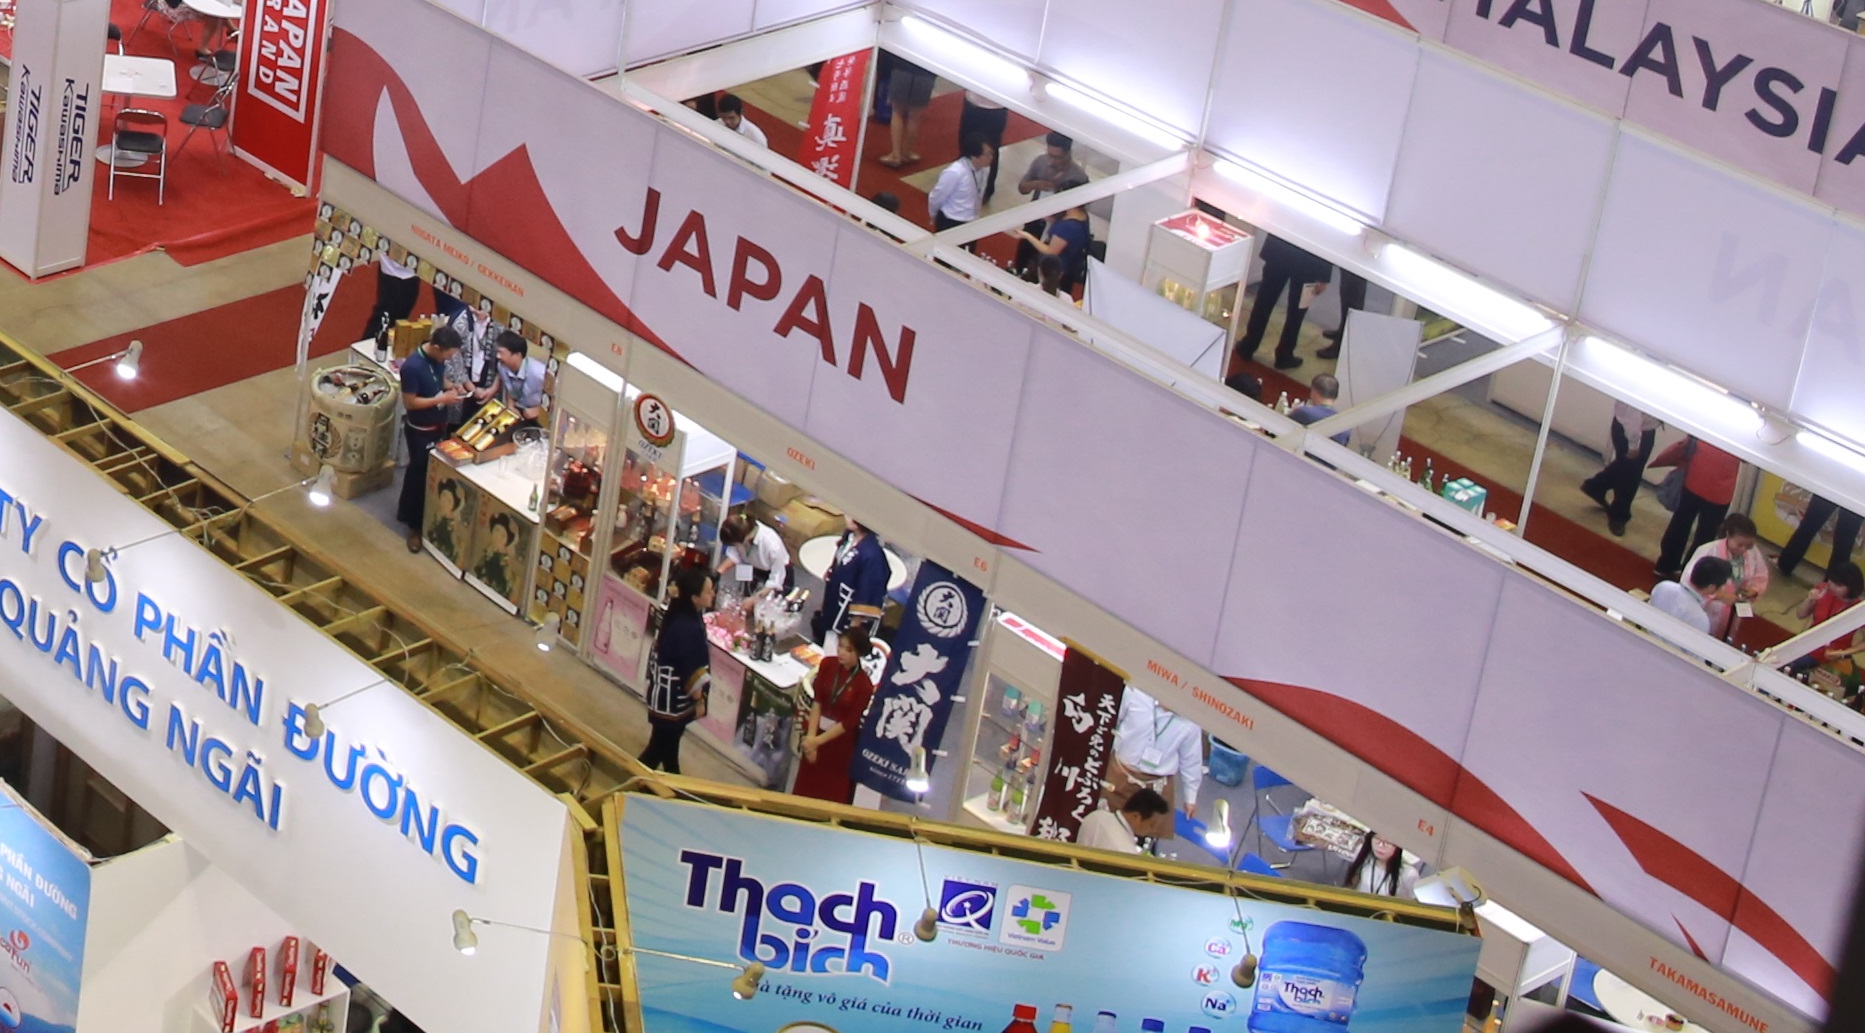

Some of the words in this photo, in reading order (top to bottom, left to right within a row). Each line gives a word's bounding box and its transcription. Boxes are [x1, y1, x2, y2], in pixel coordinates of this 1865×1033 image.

[63, 81, 90, 192] TIGER
[614, 186, 918, 405] JAPAN
[785, 445, 817, 471] OZEKI
[973, 555, 989, 573] E6
[57, 538, 120, 614] CỔ
[133, 589, 265, 728] PHẦN
[282, 699, 481, 886] ĐƯỜNG
[874, 643, 951, 760] 大関
[1145, 658, 1180, 687] MIWA
[1190, 685, 1256, 731] SHINOZAKI
[165, 702, 284, 834] NGÃI
[861, 747, 888, 767] OZEKI
[1416, 818, 1435, 837] E4
[0, 841, 33, 882] PHẦN
[6, 876, 36, 908] NGÃI
[775, 982, 815, 1008] tặng
[817, 988, 837, 1005] vô
[839, 992, 870, 1015] giá
[872, 998, 905, 1018] của
[907, 1003, 942, 1024] thời
[942, 1011, 985, 1033] gian
[1647, 954, 1770, 1033] TAKAMASAMUNE
